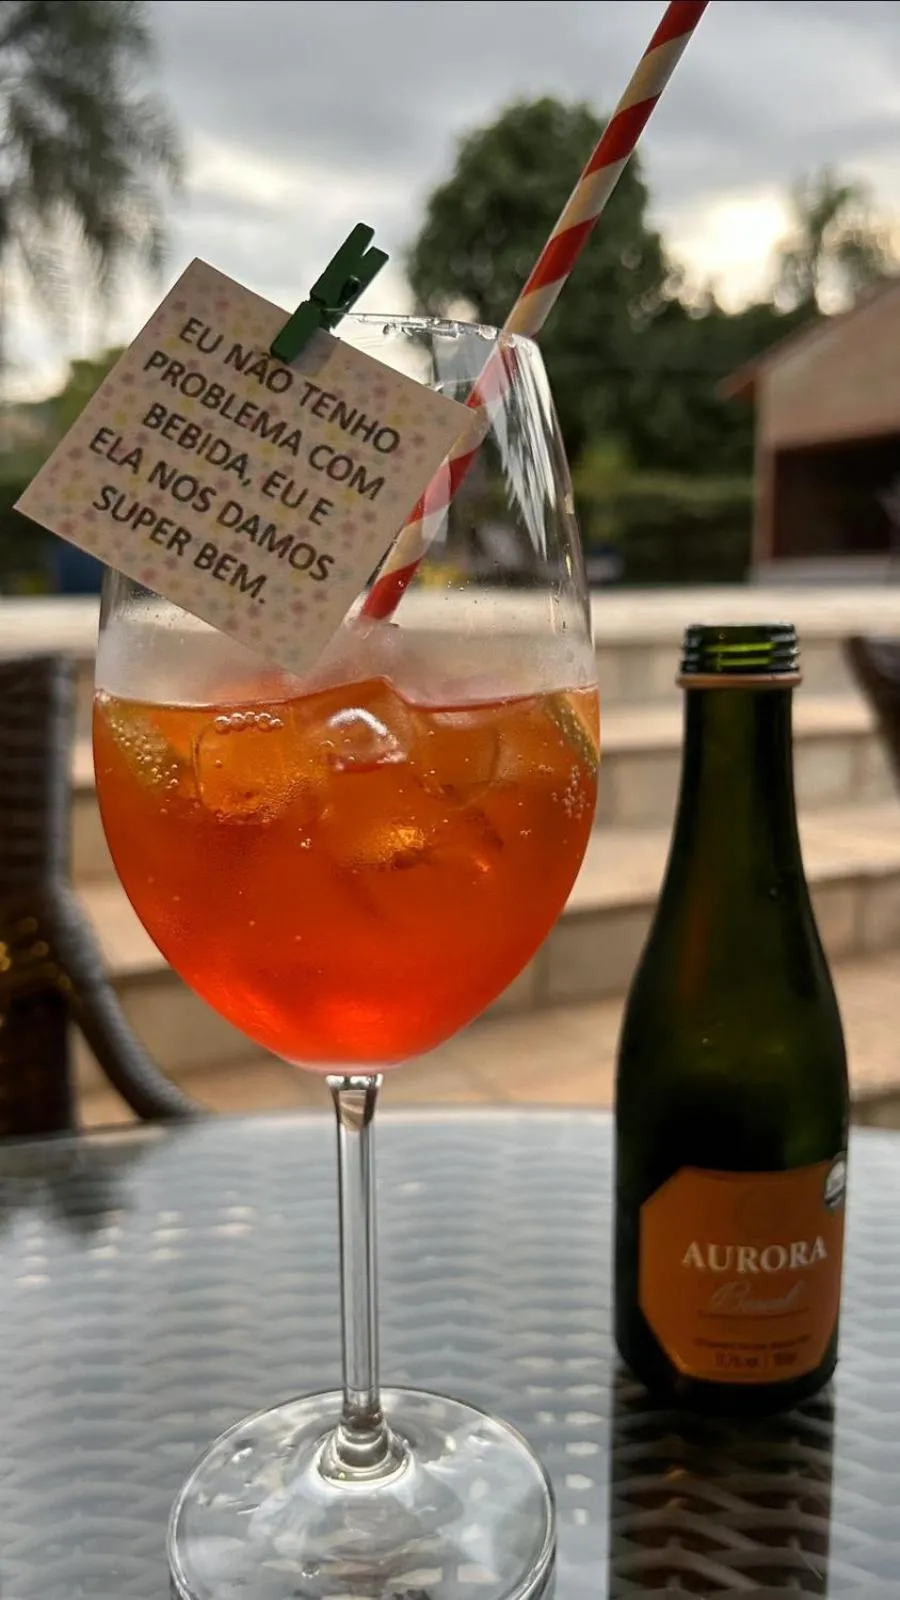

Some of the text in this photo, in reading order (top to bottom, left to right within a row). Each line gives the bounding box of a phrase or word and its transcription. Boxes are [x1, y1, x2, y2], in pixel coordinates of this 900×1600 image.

[143, 350, 386, 500] PROBLEMA COM
[178, 317, 400, 453] EU NÃO TENHO
[89, 427, 336, 581] ELA NOS DAMOS
[142, 402, 334, 526] BEBIDA, EU E
[93, 485, 267, 604] SUPER BEM.
[681, 1236, 828, 1273] AURORA
